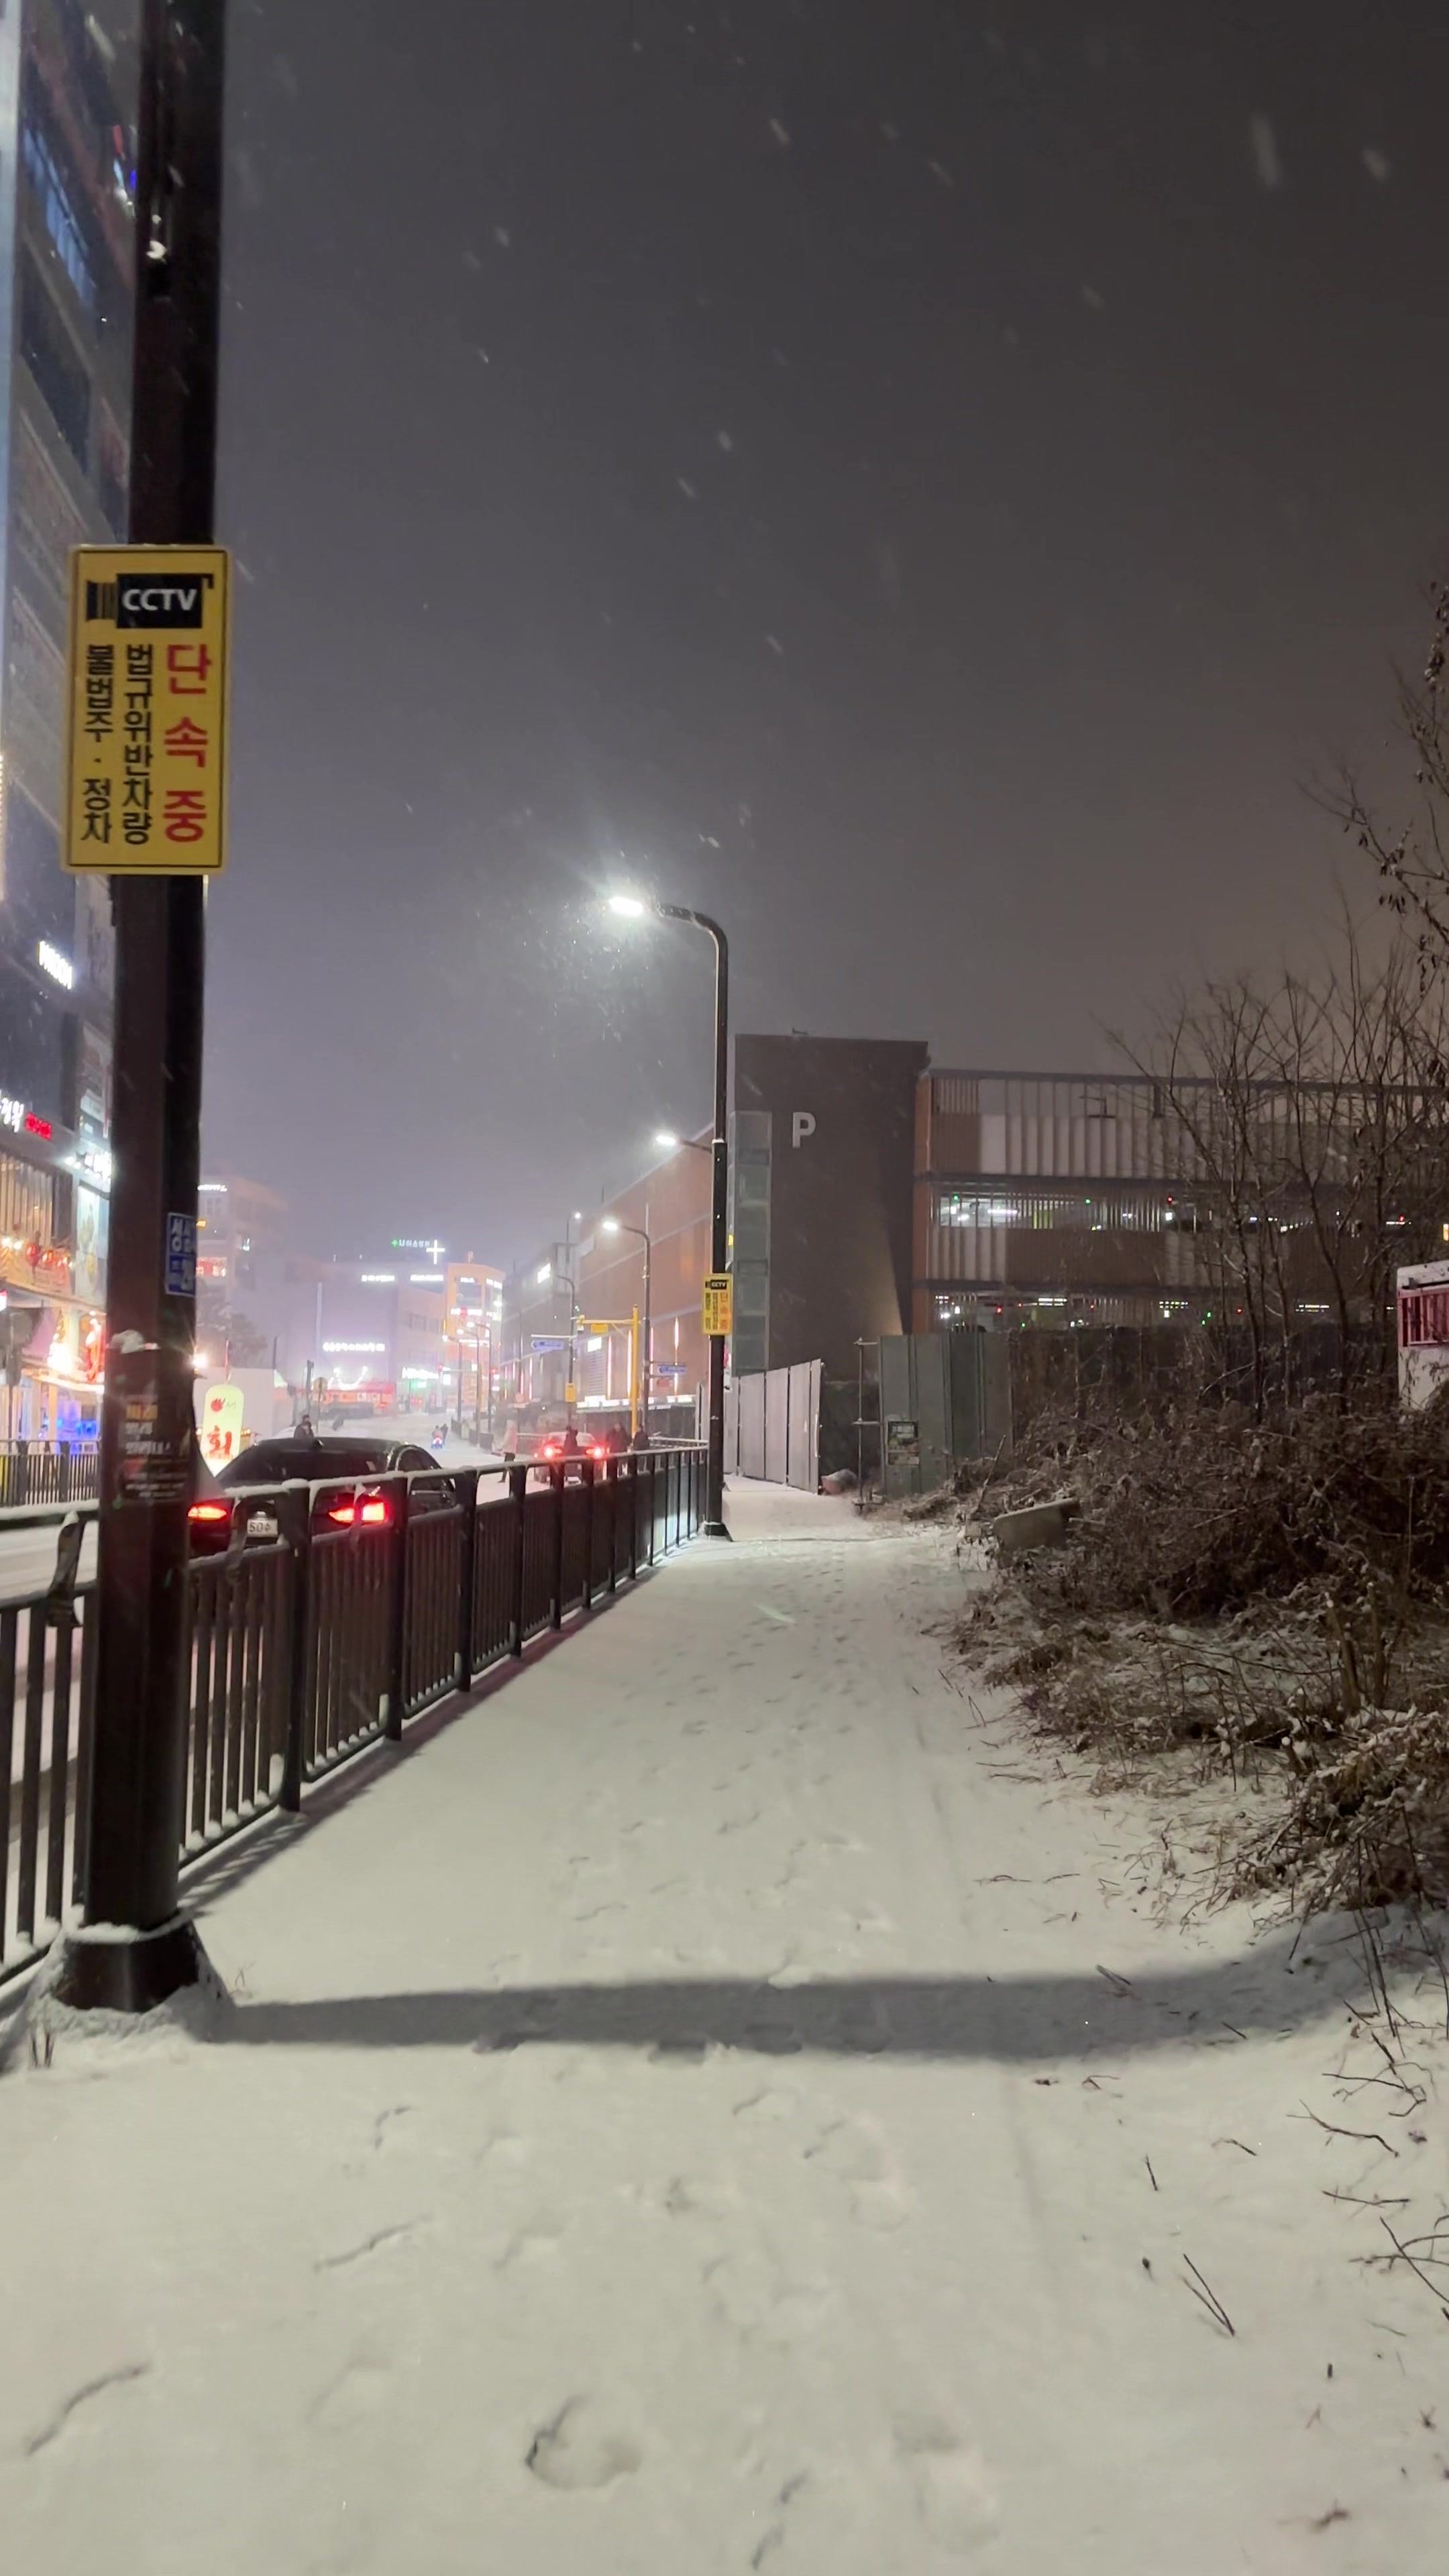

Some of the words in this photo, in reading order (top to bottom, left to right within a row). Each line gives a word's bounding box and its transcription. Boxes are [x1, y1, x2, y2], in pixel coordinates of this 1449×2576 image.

[122, 588, 197, 611] CCTV
[122, 644, 153, 845] 법규위반차량
[792, 1112, 816, 1148] P
